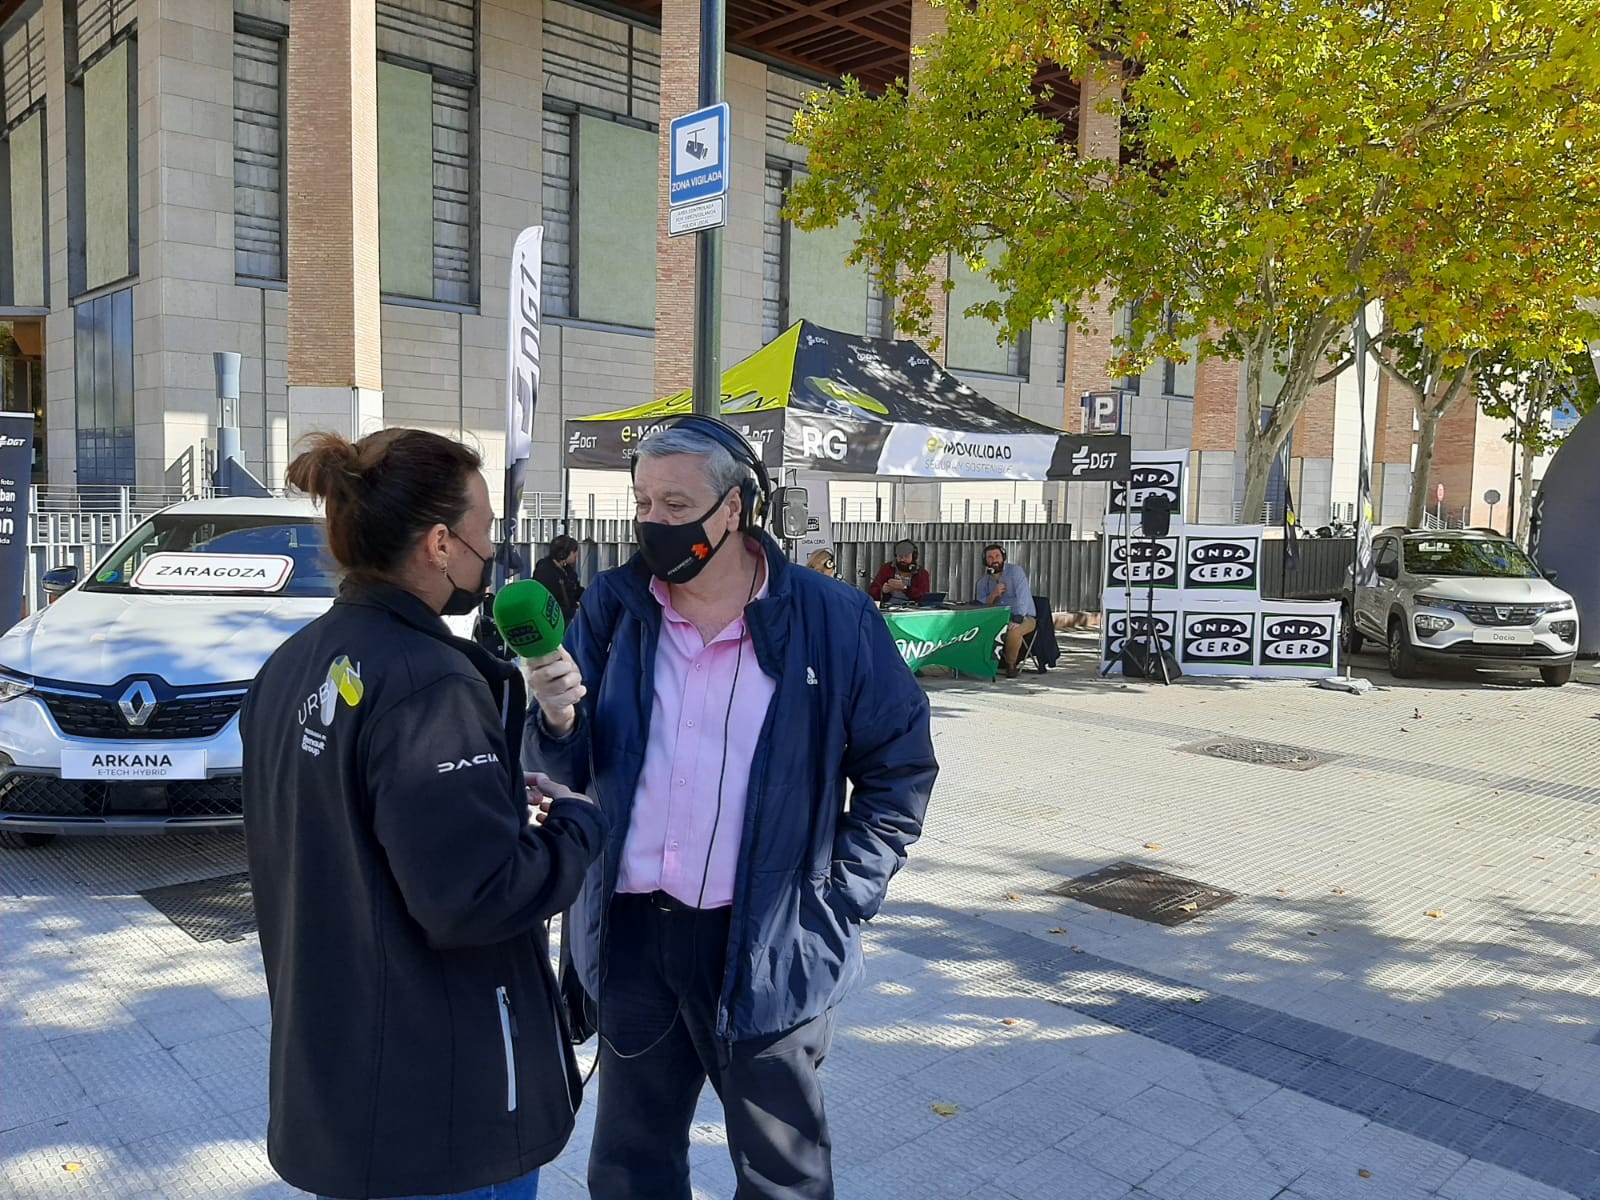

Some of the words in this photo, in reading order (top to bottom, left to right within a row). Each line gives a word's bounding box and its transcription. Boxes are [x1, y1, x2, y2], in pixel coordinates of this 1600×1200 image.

[672, 179, 691, 192] ZONA
[691, 170, 722, 187] VIGILADA
[520, 251, 540, 367] DGT
[1094, 396, 1114, 428] P
[6, 438, 26, 446] DGT
[580, 436, 598, 449] DGT
[802, 426, 848, 461] RG
[1090, 452, 1117, 470] DGT
[1129, 474, 1169, 482] NDA
[1119, 546, 1167, 556] ONDA
[1196, 547, 1246, 558] ONDA
[156, 565, 266, 578] ZARAGOZA
[1198, 566, 1244, 578] CERO
[1193, 623, 1242, 634] ONDA
[1272, 625, 1322, 636] ONDA
[1492, 633, 1516, 642] Dacia
[1196, 642, 1241, 653] CERO
[1274, 644, 1320, 656] CERO
[92, 754, 173, 768] ARKANA
